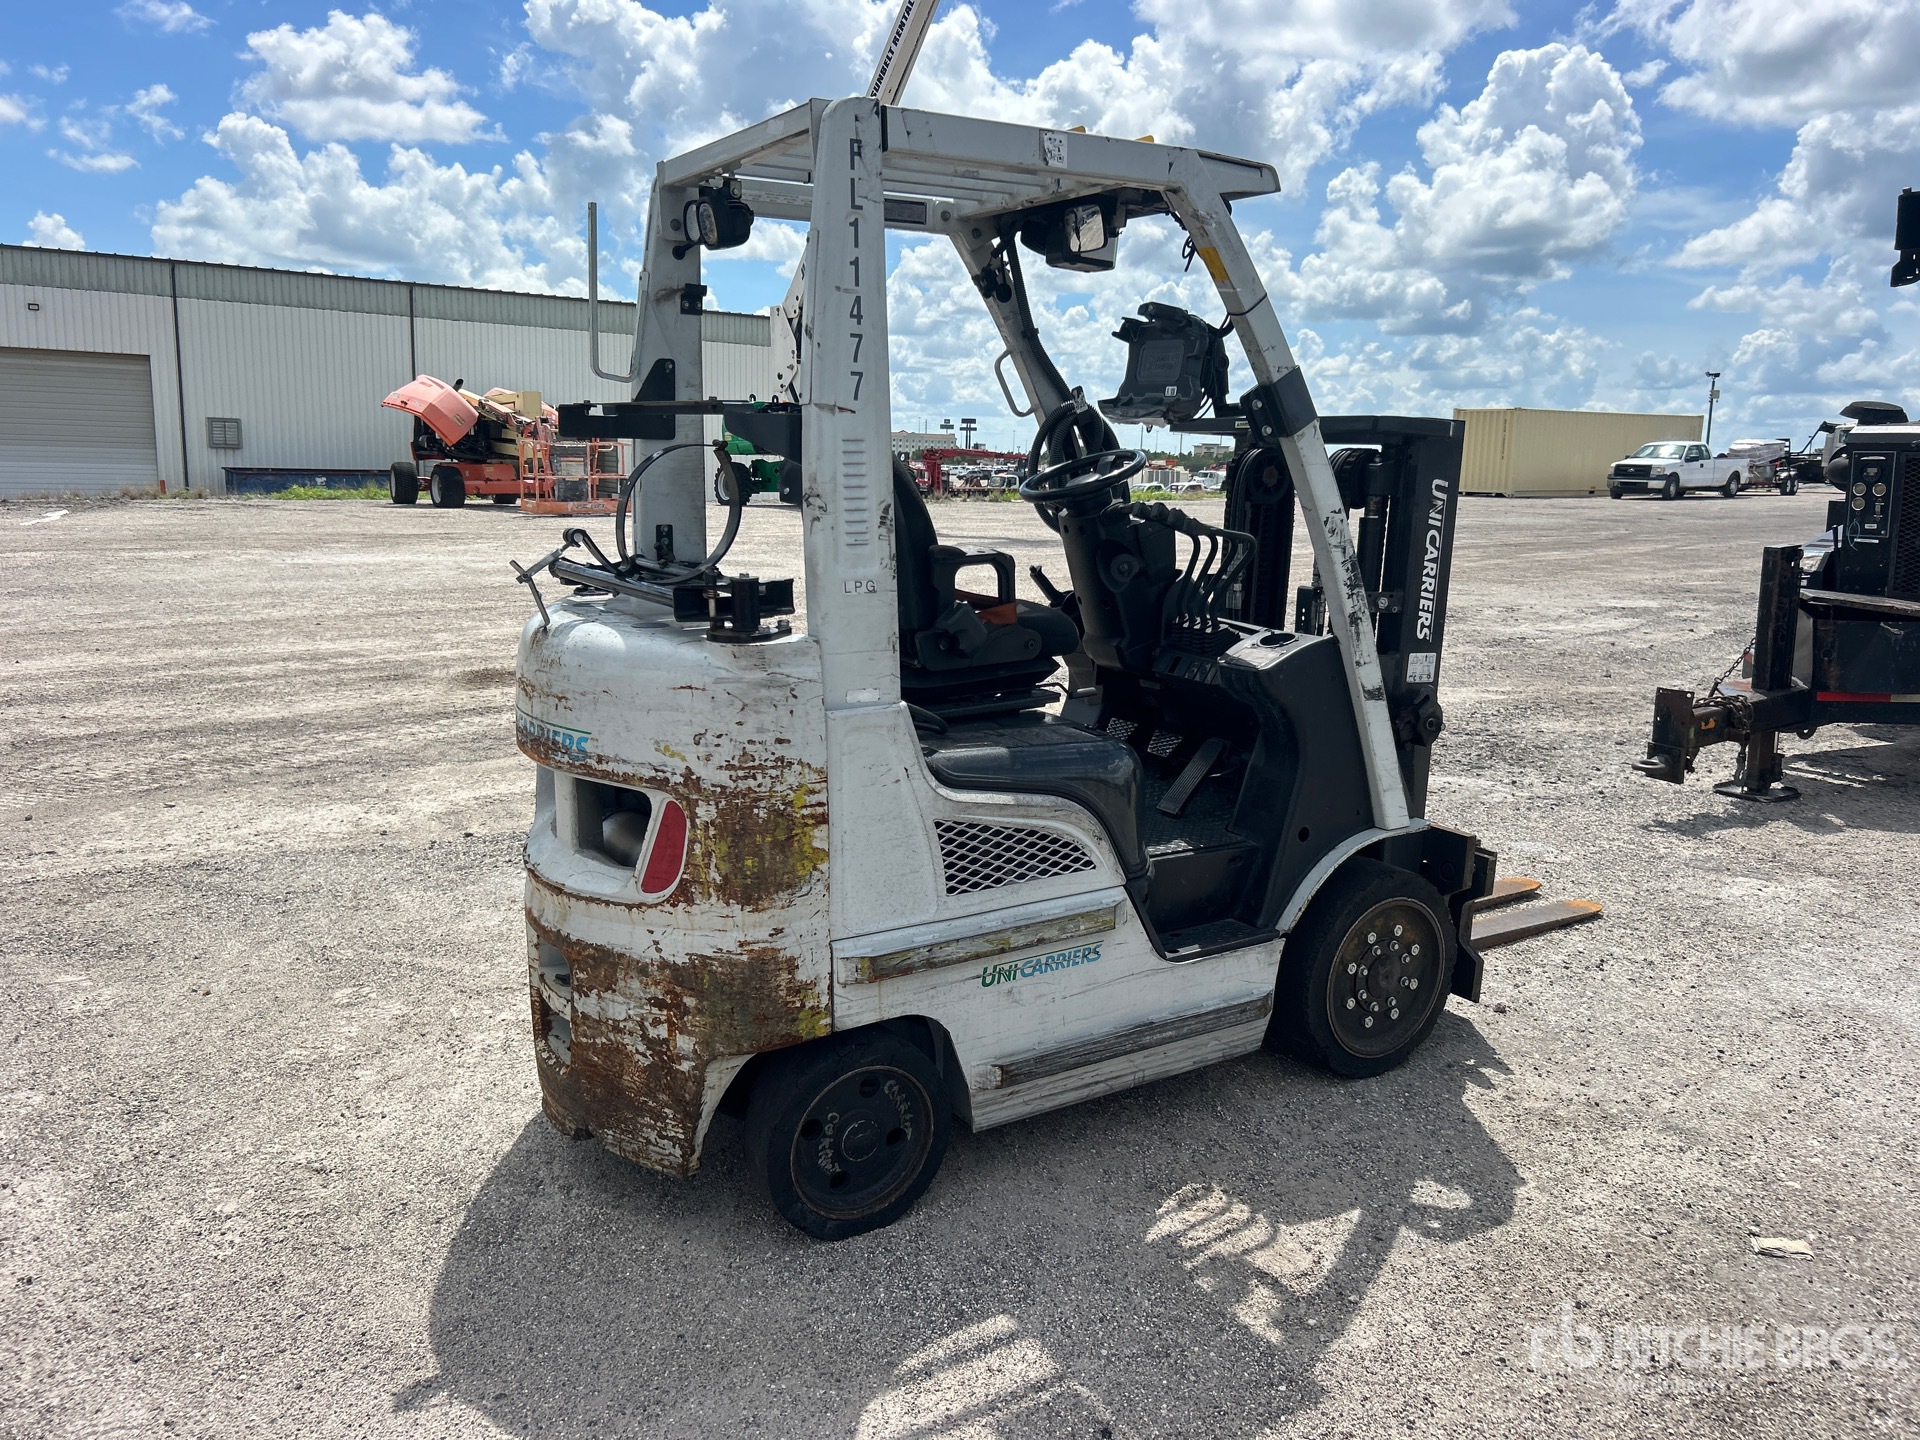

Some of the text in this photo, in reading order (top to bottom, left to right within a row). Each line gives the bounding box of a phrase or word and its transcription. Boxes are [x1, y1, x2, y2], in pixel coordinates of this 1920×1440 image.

[870, 0, 915, 97] SUNBELT RENTAL
[844, 580, 877, 594] LPG
[1415, 478, 1450, 643] UNICARRIERS
[981, 943, 1103, 988] UNICARRIERS
